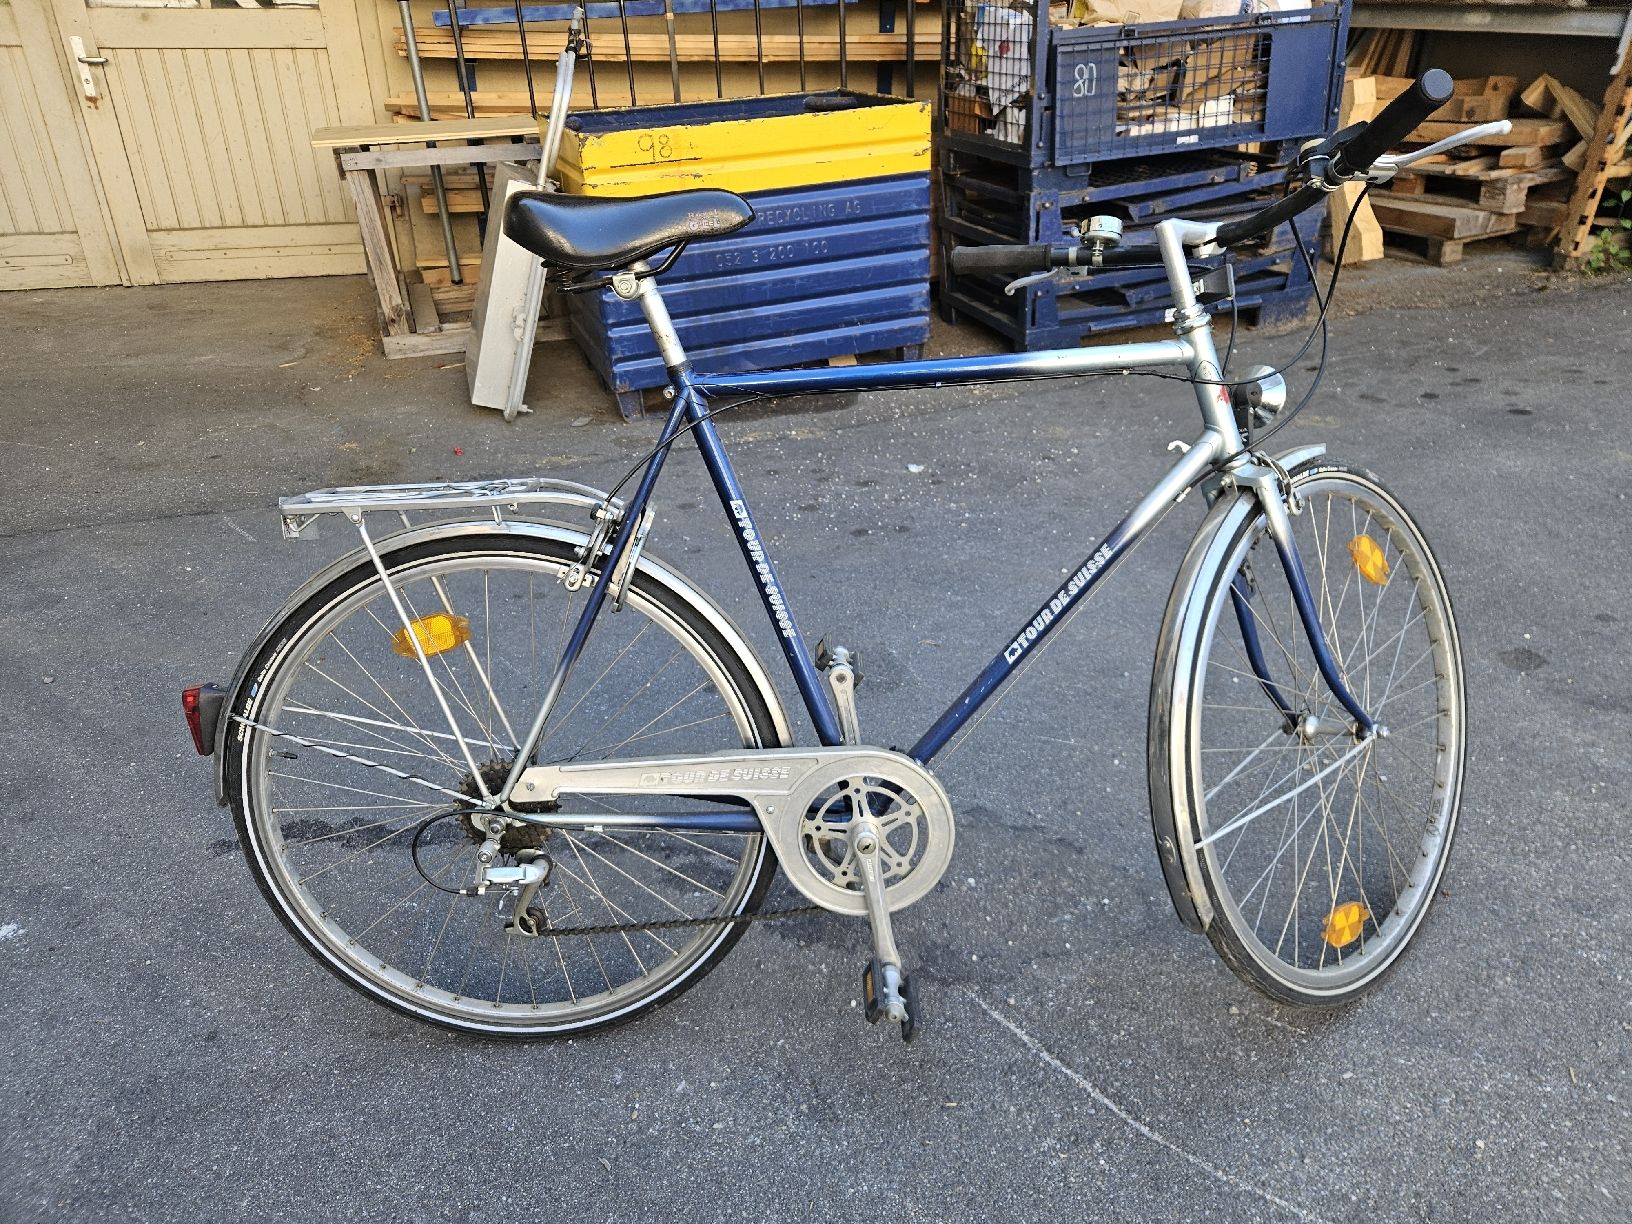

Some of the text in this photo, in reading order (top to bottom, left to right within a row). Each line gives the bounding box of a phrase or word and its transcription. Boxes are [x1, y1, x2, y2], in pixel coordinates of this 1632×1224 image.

[637, 133, 673, 161] 98
[757, 199, 862, 226] RECYCLING AG
[738, 518, 797, 638] TOUR DE SUISSE
[1017, 542, 1114, 648] TOUR DE SUISSE
[238, 698, 253, 741] SCHALBE
[659, 766, 791, 785] TOUR DE SUISSE
